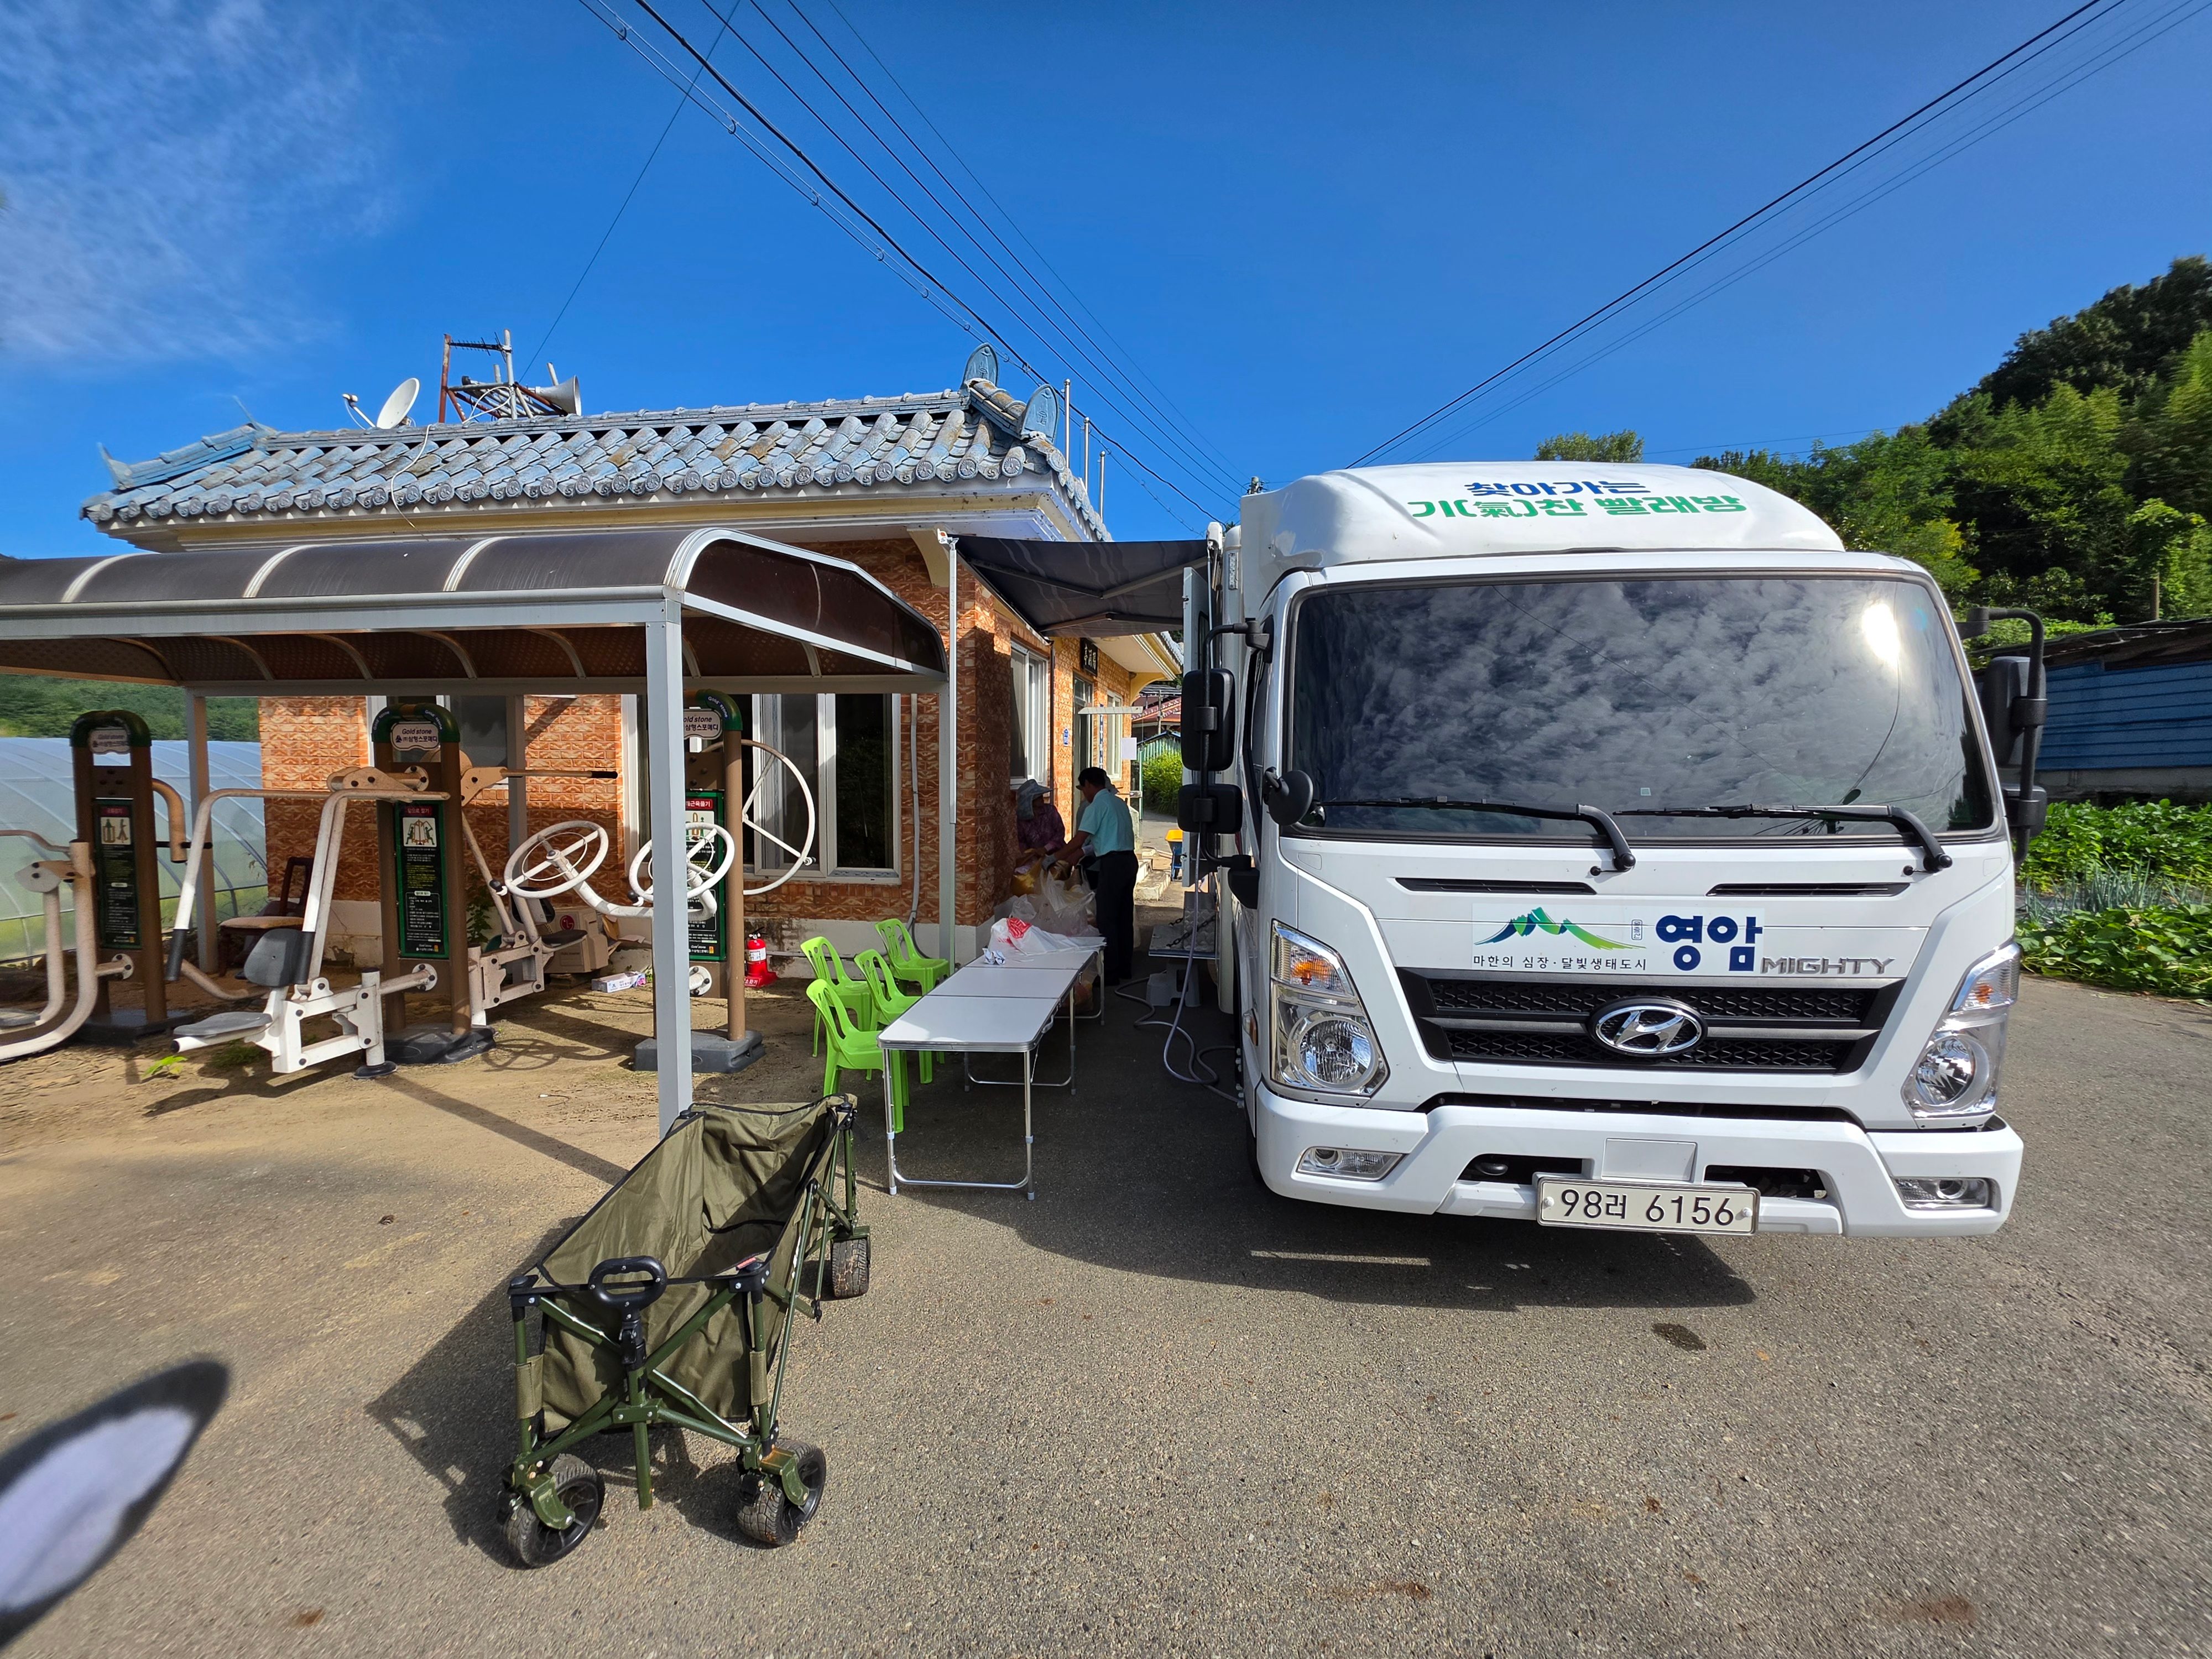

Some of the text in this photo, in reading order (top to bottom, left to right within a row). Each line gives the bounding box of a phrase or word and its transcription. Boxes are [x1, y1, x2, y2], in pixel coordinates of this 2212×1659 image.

[1464, 481, 1651, 497] 찾아가는
[1407, 495, 1747, 518] 기(氣)찬 빨래방
[1656, 915, 1763, 972] 영암
[1473, 956, 1514, 968] 마한의
[1762, 956, 1895, 975] MIGHTY
[1561, 1189, 1734, 1226] 98러 6156
